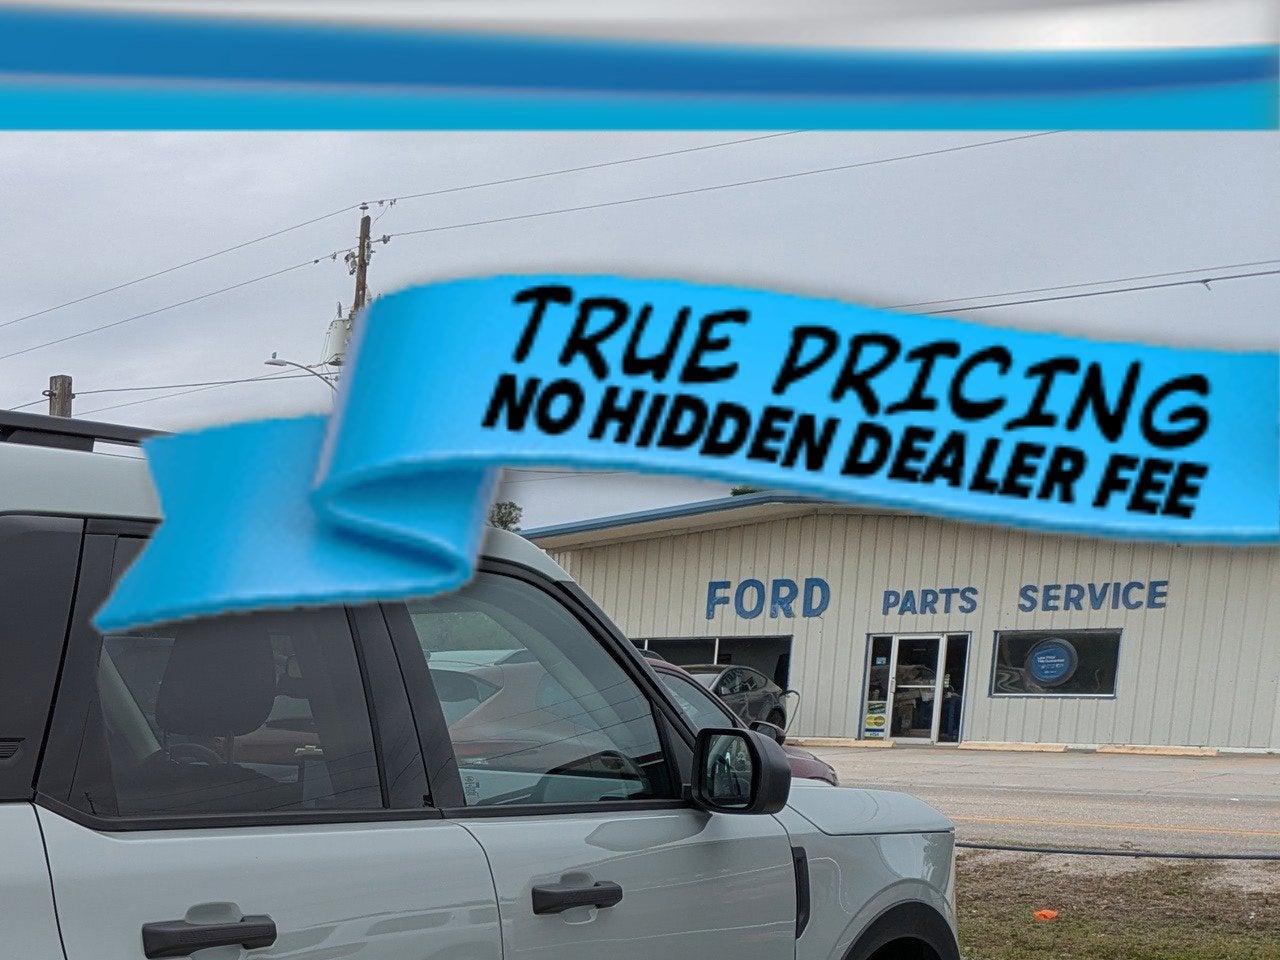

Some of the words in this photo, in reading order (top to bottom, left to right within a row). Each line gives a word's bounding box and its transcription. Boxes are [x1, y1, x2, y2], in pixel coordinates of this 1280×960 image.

[705, 577, 831, 619] FORD
[881, 586, 979, 616] PARTS
[1018, 580, 1169, 613] SERVICE
